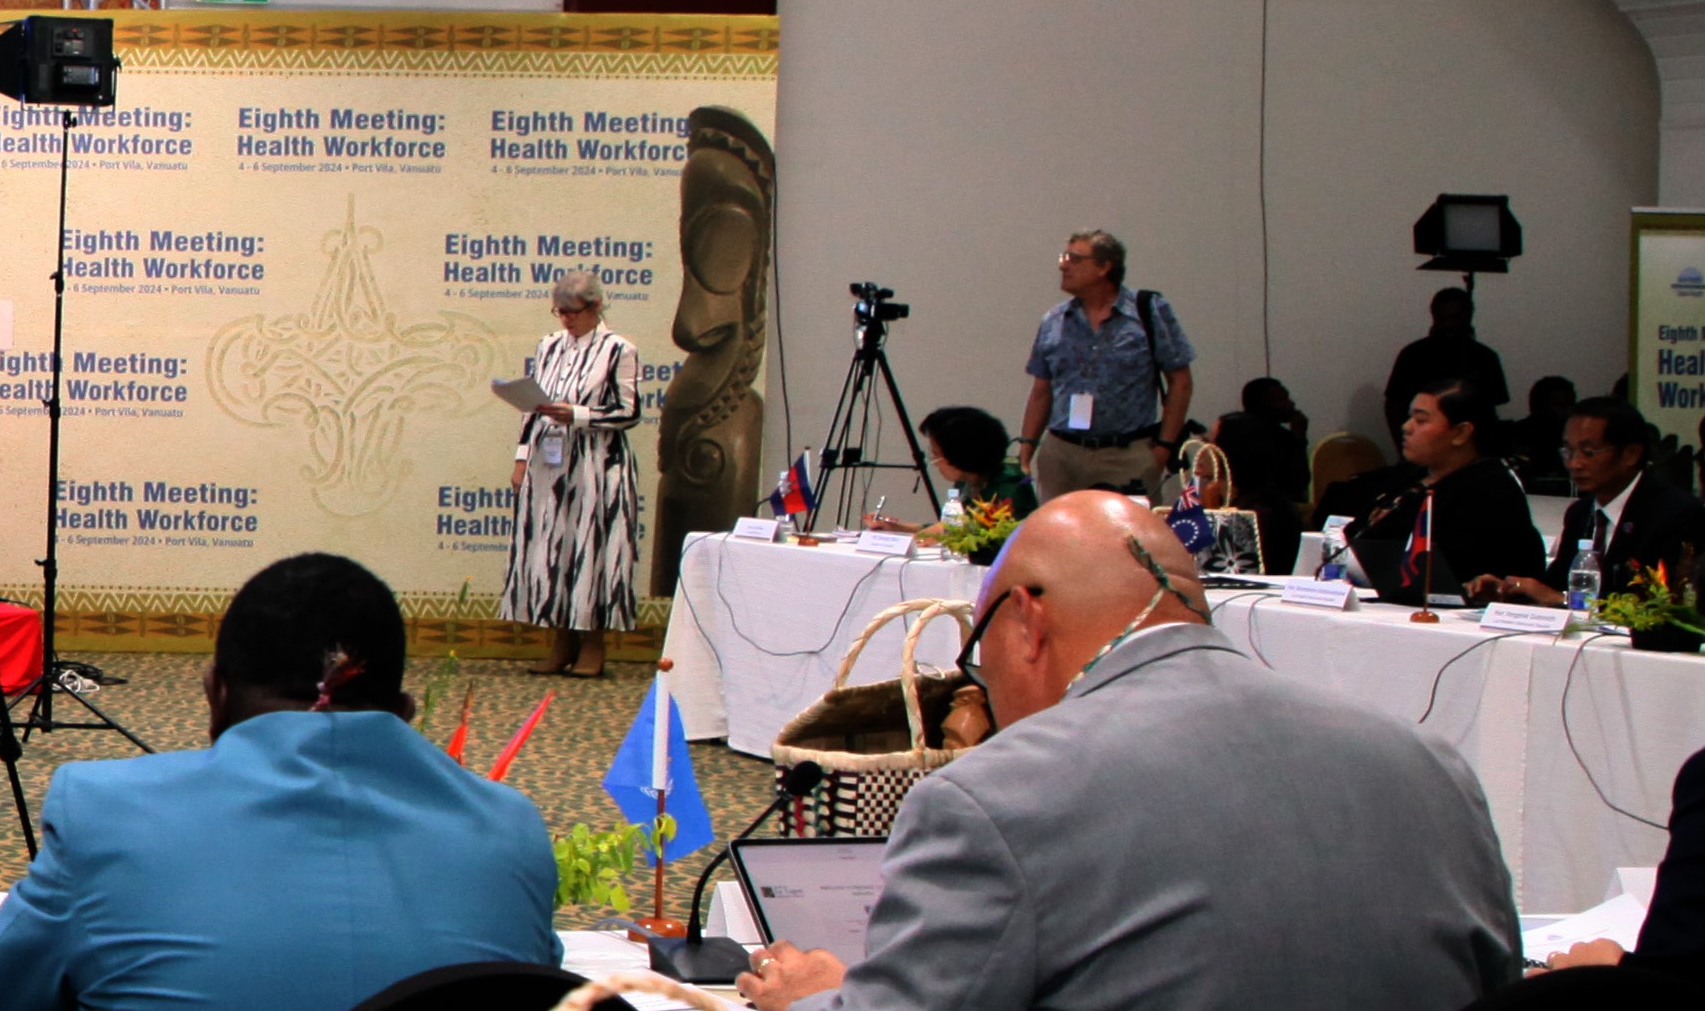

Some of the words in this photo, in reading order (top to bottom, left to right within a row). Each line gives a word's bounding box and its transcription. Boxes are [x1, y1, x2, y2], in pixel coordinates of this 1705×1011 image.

[77, 106, 192, 132] Meeting:
[239, 107, 320, 133] Eighth
[330, 109, 446, 135] Meeting:
[491, 110, 574, 135] Eighth
[584, 111, 690, 137] Meeting
[71, 133, 193, 155] Workforce
[238, 135, 315, 156] Health
[324, 136, 446, 158] Workforce
[491, 138, 569, 159] Health
[262, 162, 316, 173] September
[319, 163, 342, 172] 2024
[352, 164, 373, 173] Port
[400, 164, 442, 173] Vanuatu
[63, 230, 140, 255] Eighth
[150, 231, 265, 257] Meeting:
[445, 233, 527, 259] Eighth
[538, 235, 654, 262] Meeting:
[143, 258, 266, 280] Workforce
[444, 262, 521, 283] Health
[1658, 325, 1697, 344] Eighth
[74, 352, 189, 378] Meeting:
[67, 379, 189, 402] Workforce
[144, 481, 259, 508] Meeting:
[137, 509, 259, 533] Workforce
[437, 514, 512, 536] Health
